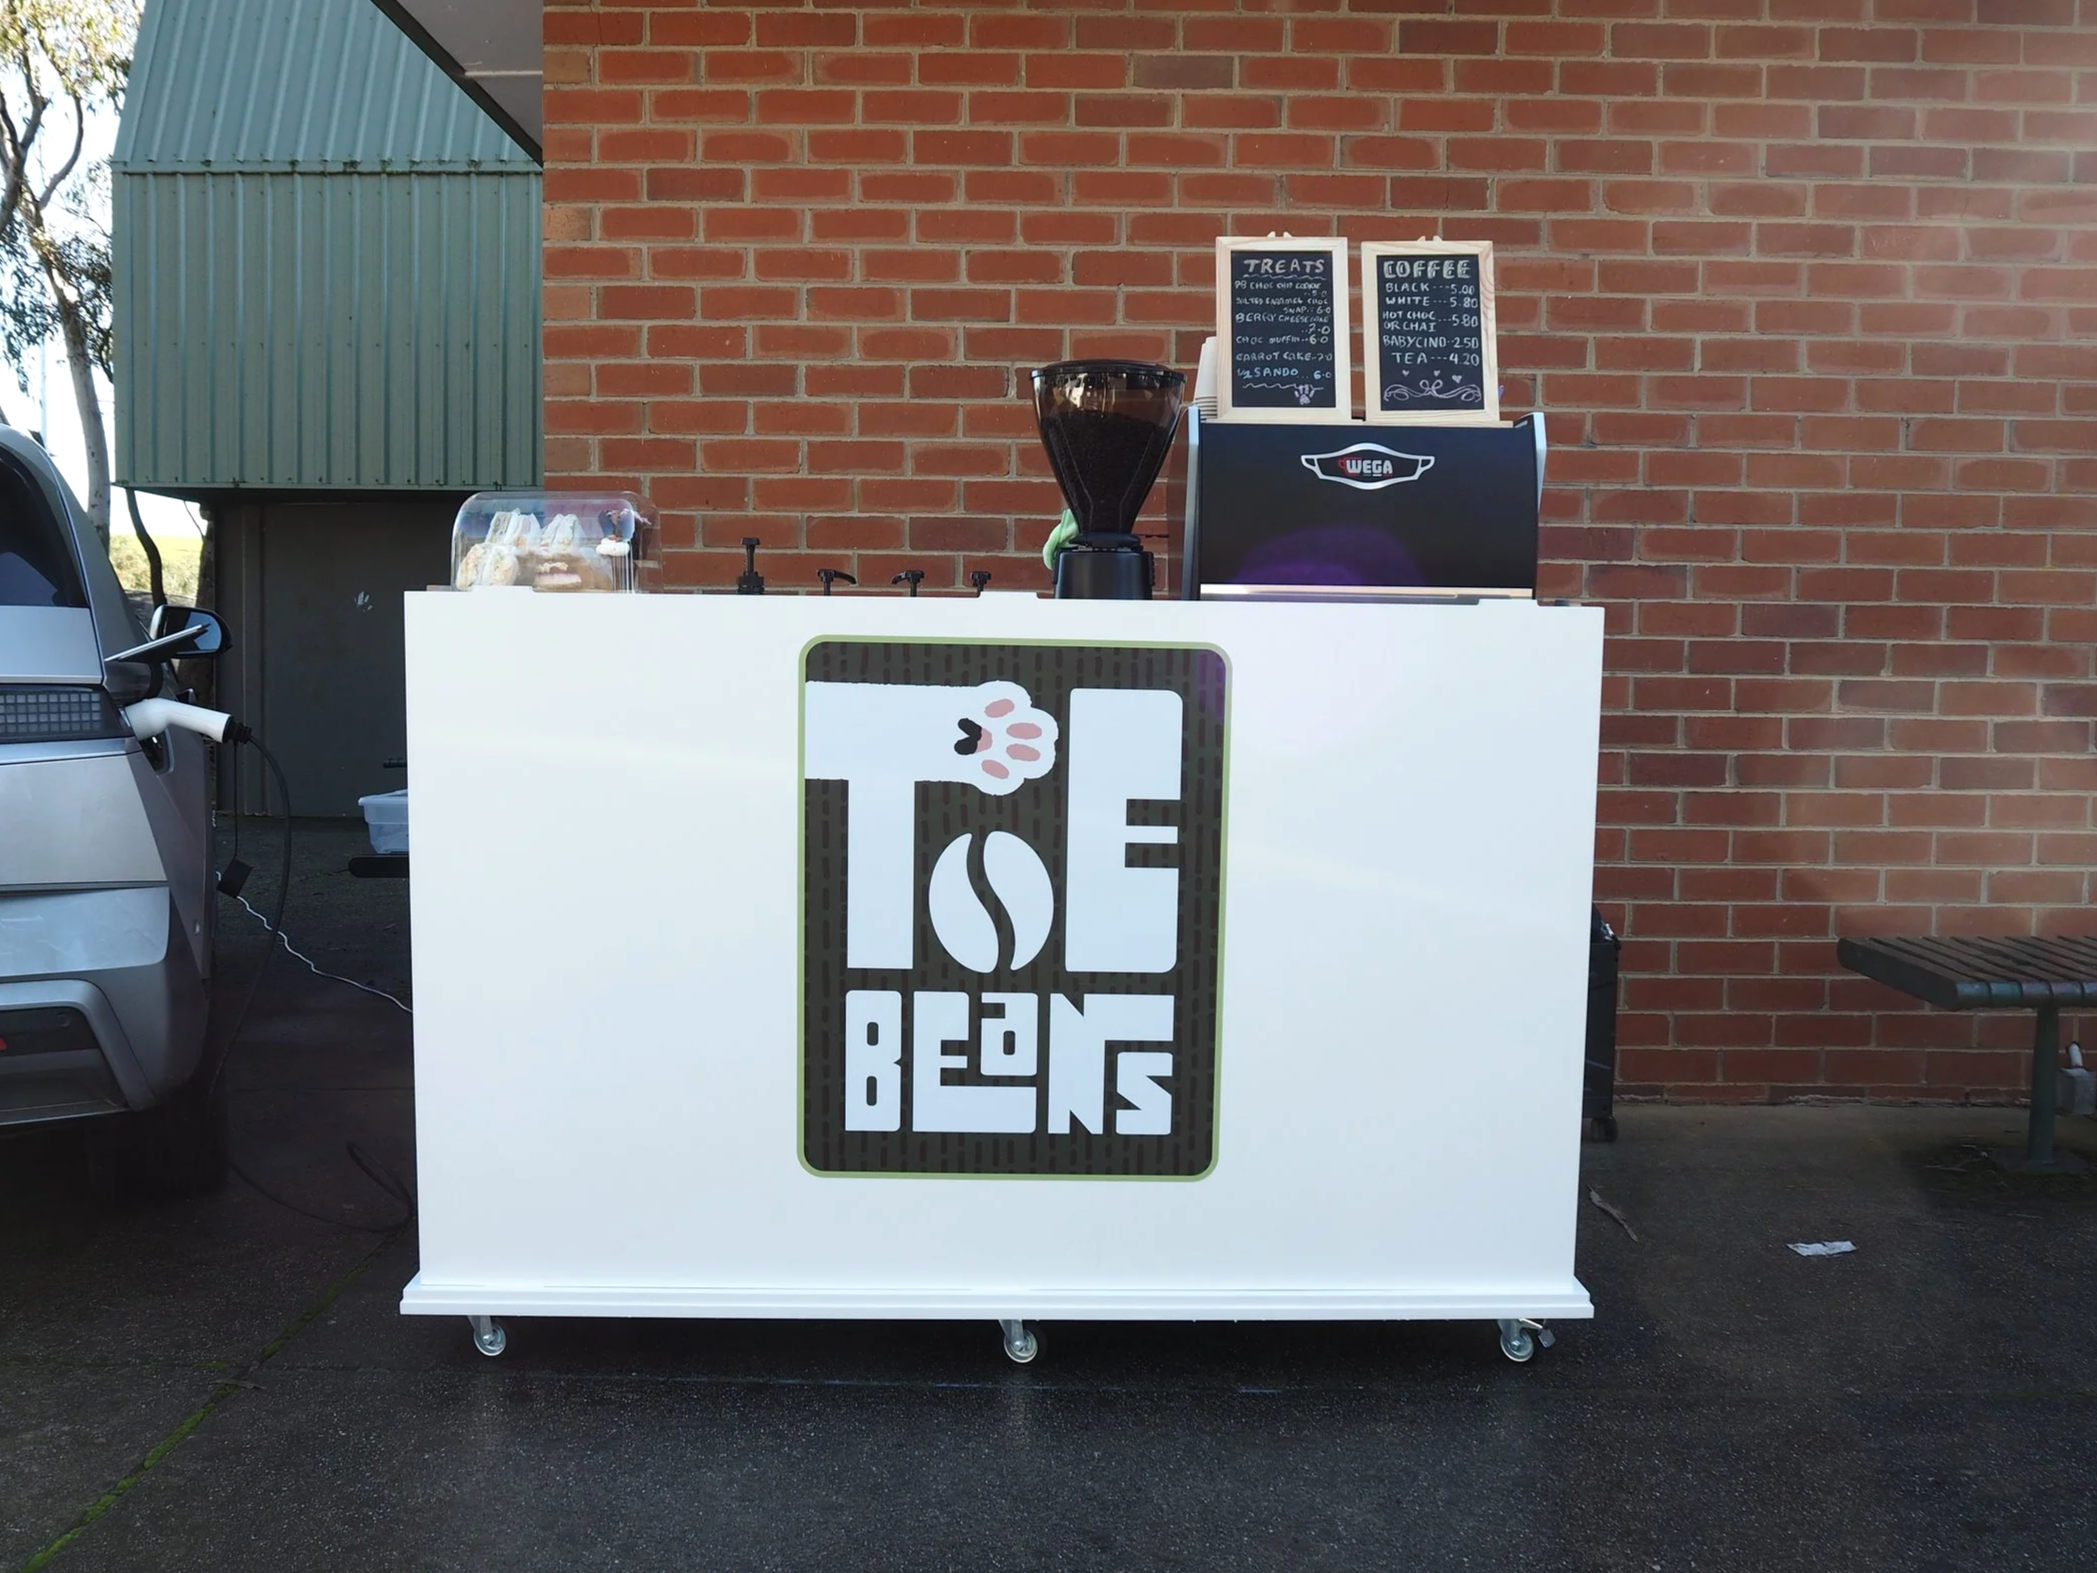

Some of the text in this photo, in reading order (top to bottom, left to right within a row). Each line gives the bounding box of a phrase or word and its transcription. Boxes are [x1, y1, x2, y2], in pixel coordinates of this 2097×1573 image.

[1243, 258, 1325, 273] TREATS
[1383, 259, 1471, 279] COFFEE
[1385, 282, 1430, 293] BLACK
[1385, 296, 1430, 307] WHITE
[1235, 312, 1276, 323] BERRY
[1382, 310, 1403, 320] HOT
[1406, 310, 1436, 320] CHOC
[1383, 321, 1436, 332] OR CHAI
[1236, 335, 1263, 345] CHOC
[1382, 335, 1447, 348] BABYCINO
[1236, 351, 1280, 361] CARROT
[1391, 352, 1428, 364] TEA
[1345, 459, 1394, 474] WEGA
[805, 680, 1183, 974] TOE
